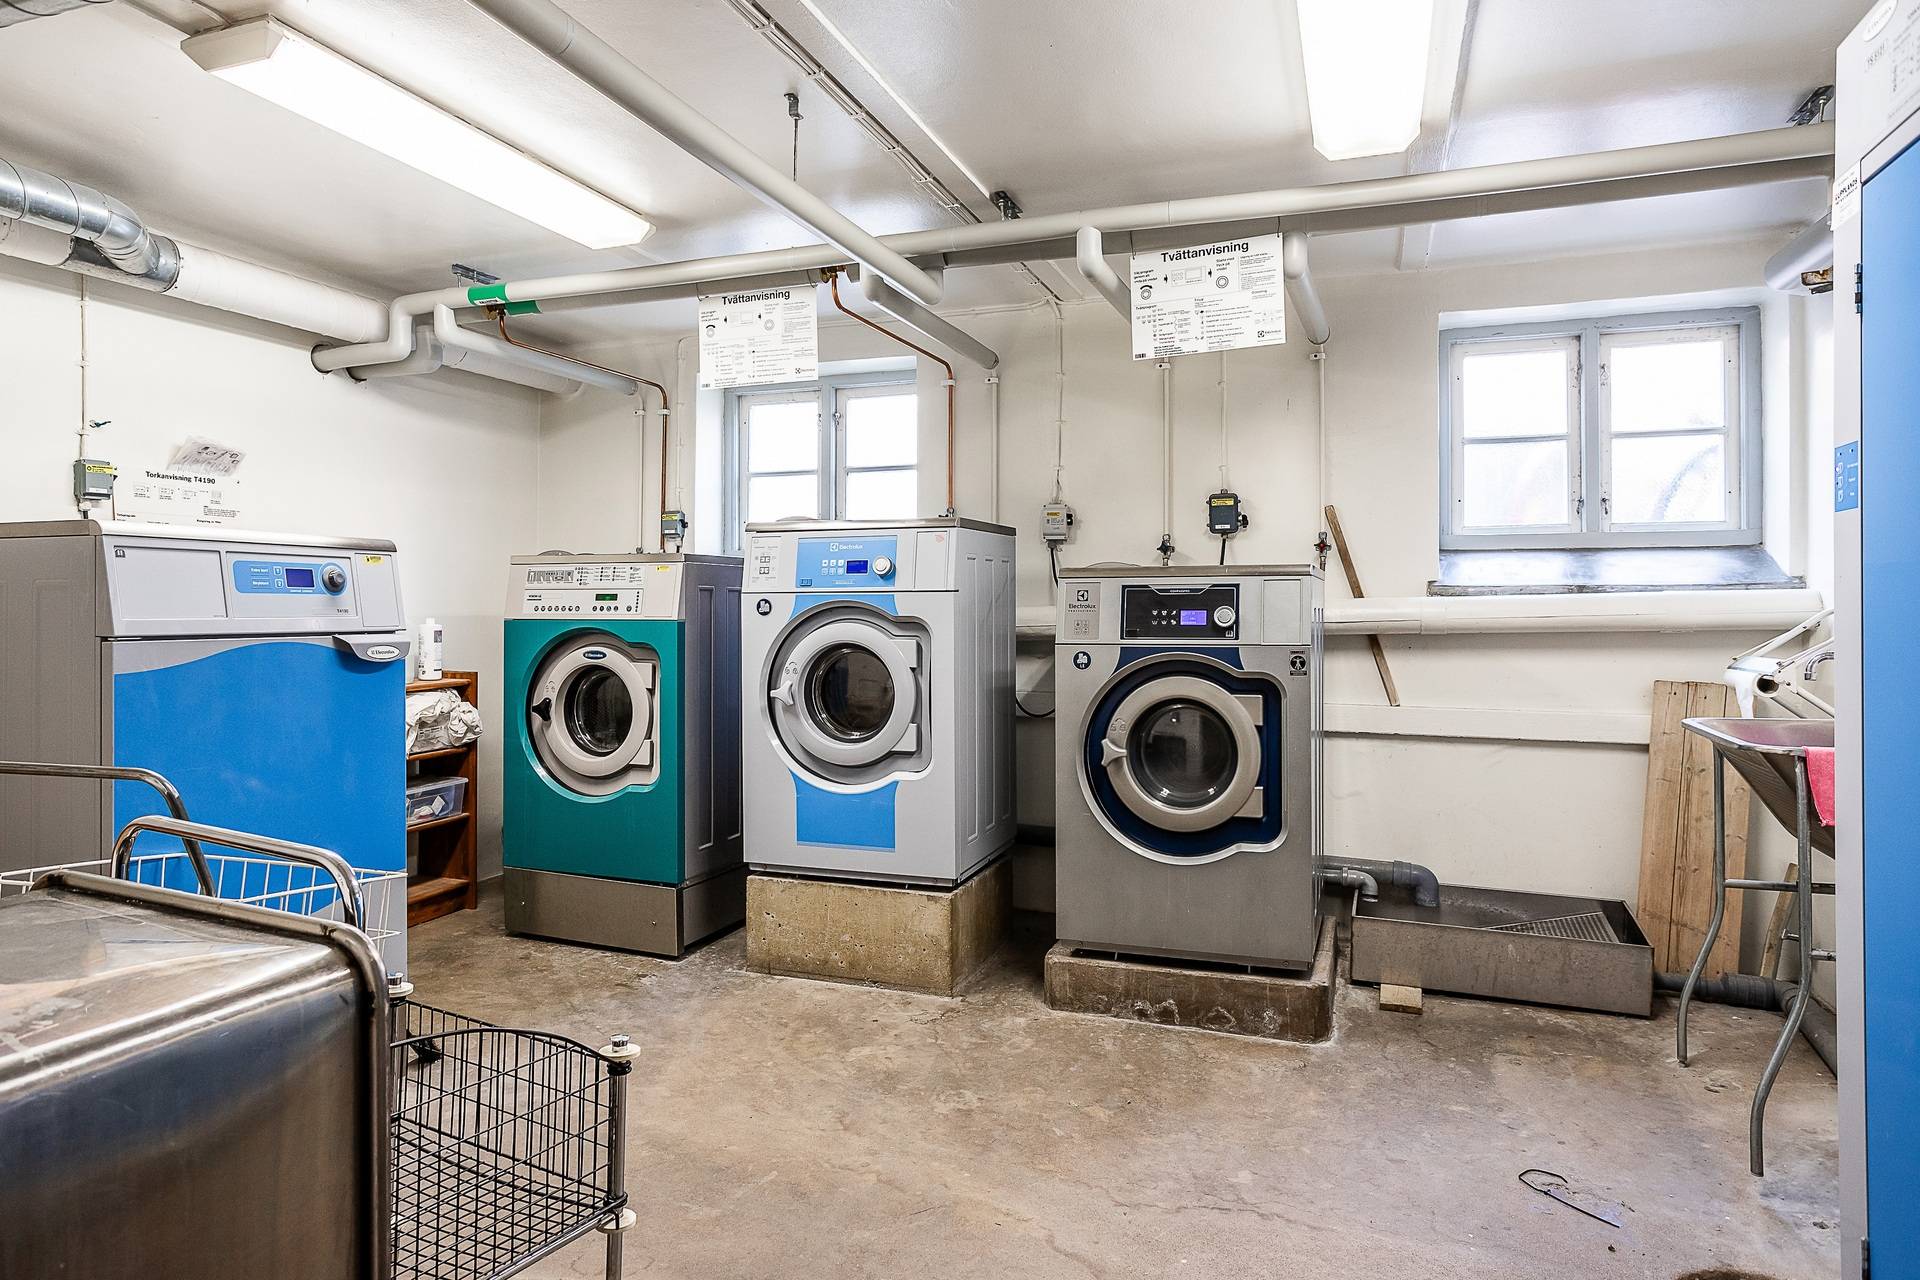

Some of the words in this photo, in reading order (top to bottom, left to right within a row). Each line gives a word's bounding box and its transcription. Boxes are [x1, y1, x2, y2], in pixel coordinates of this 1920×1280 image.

[1160, 241, 1249, 263] Tvättanvisning
[721, 289, 791, 306] Tvättanvisning
[145, 470, 192, 483] Torkanvisning
[193, 476, 216, 485] T4190
